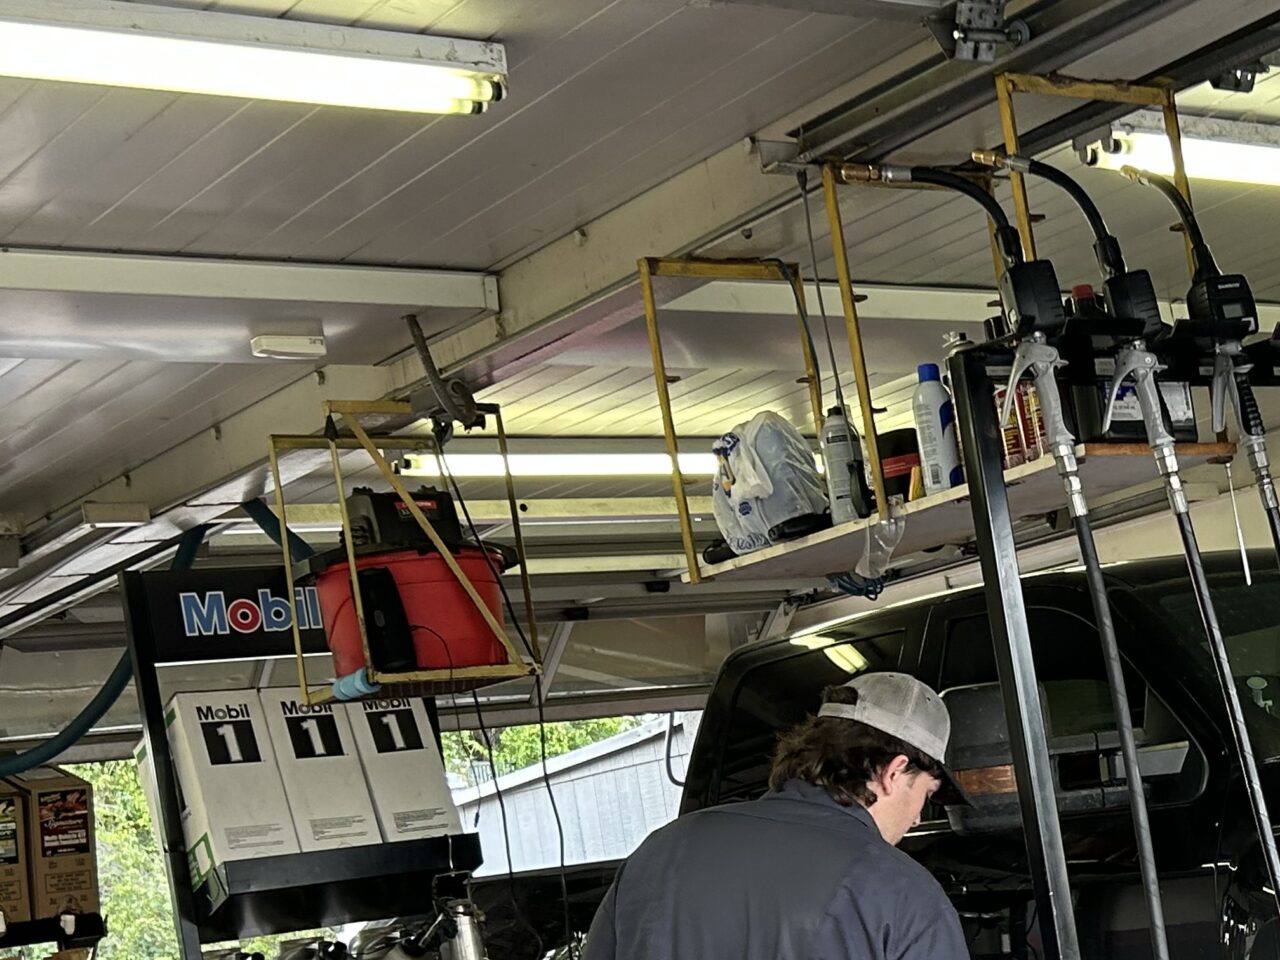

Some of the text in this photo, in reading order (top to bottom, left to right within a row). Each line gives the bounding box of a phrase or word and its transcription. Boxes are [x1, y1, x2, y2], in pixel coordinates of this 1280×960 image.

[179, 587, 323, 636] Mobil
[196, 704, 250, 721] Mobil
[381, 713, 406, 749] 1
[216, 723, 244, 762] 1
[300, 718, 327, 756] 1
